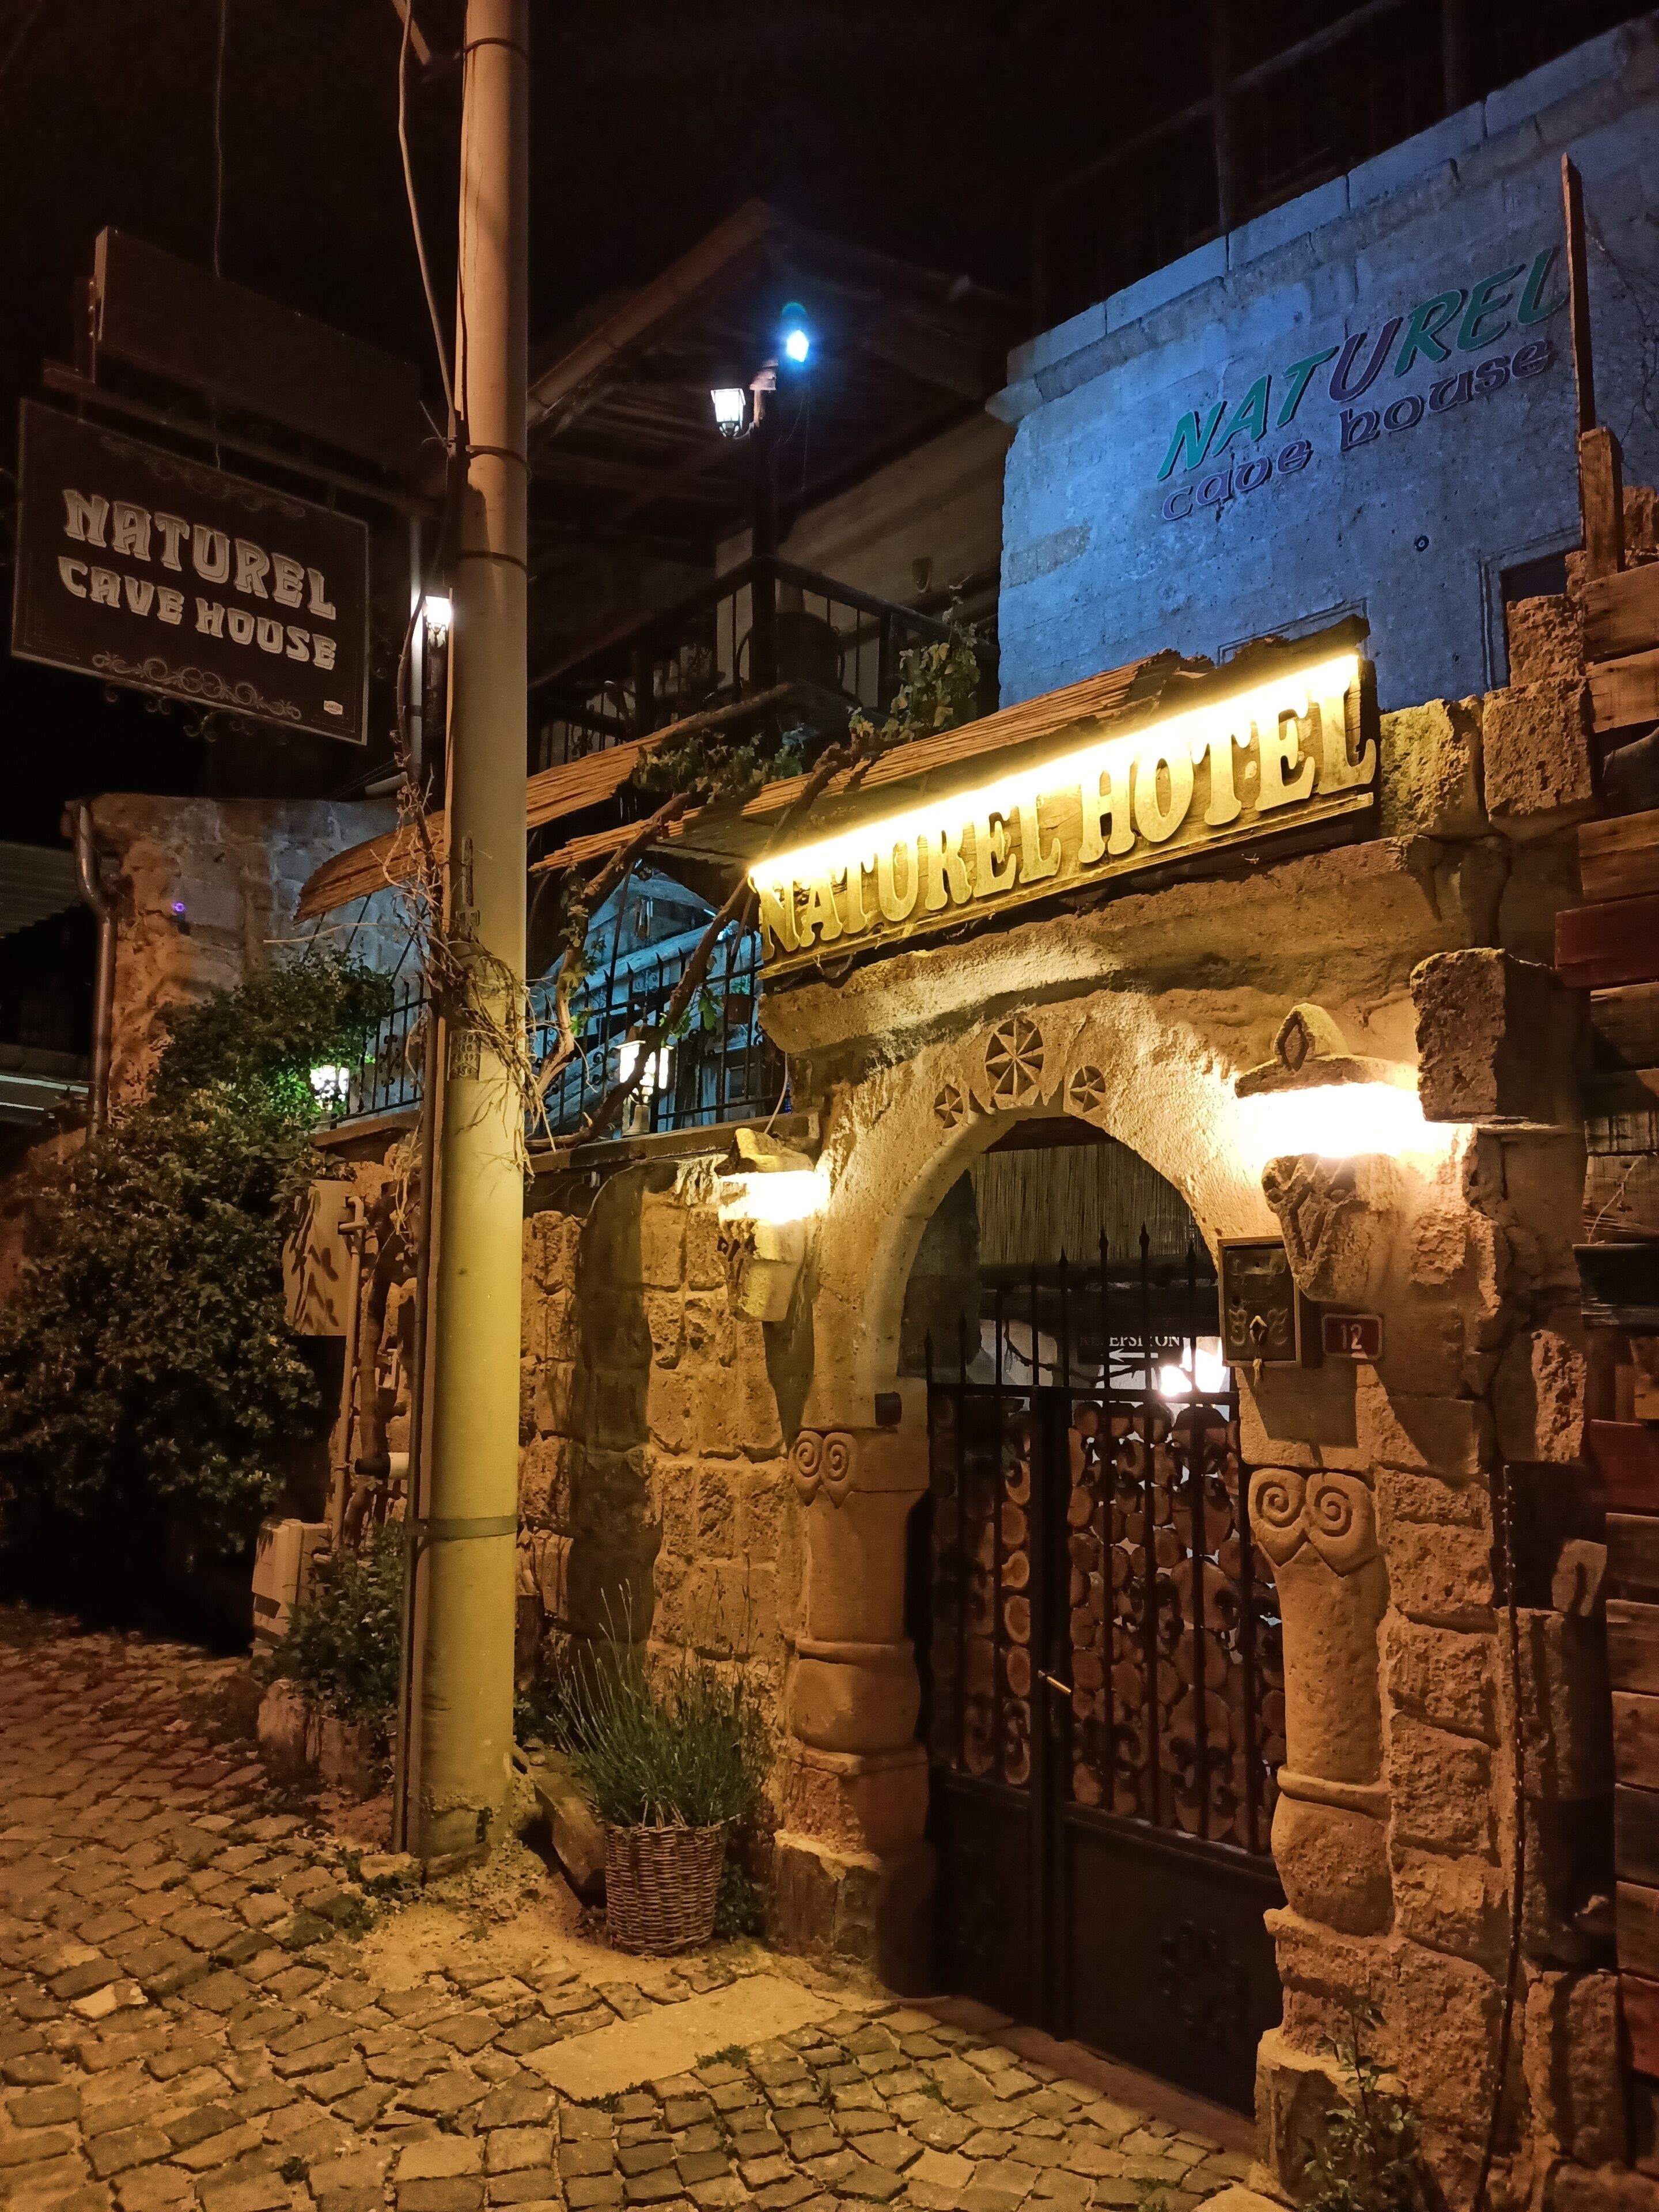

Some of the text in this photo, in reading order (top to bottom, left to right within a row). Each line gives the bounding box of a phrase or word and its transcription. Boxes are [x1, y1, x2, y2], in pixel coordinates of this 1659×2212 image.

[1158, 247, 1570, 480] NATUREL
[1162, 339, 1552, 521] cave house
[58, 556, 337, 670] CAVE HOUSE
[62, 488, 336, 620] NATUREL
[751, 668, 1377, 960] NATUREL HOTEL
[1340, 1324, 1362, 1349] 12
